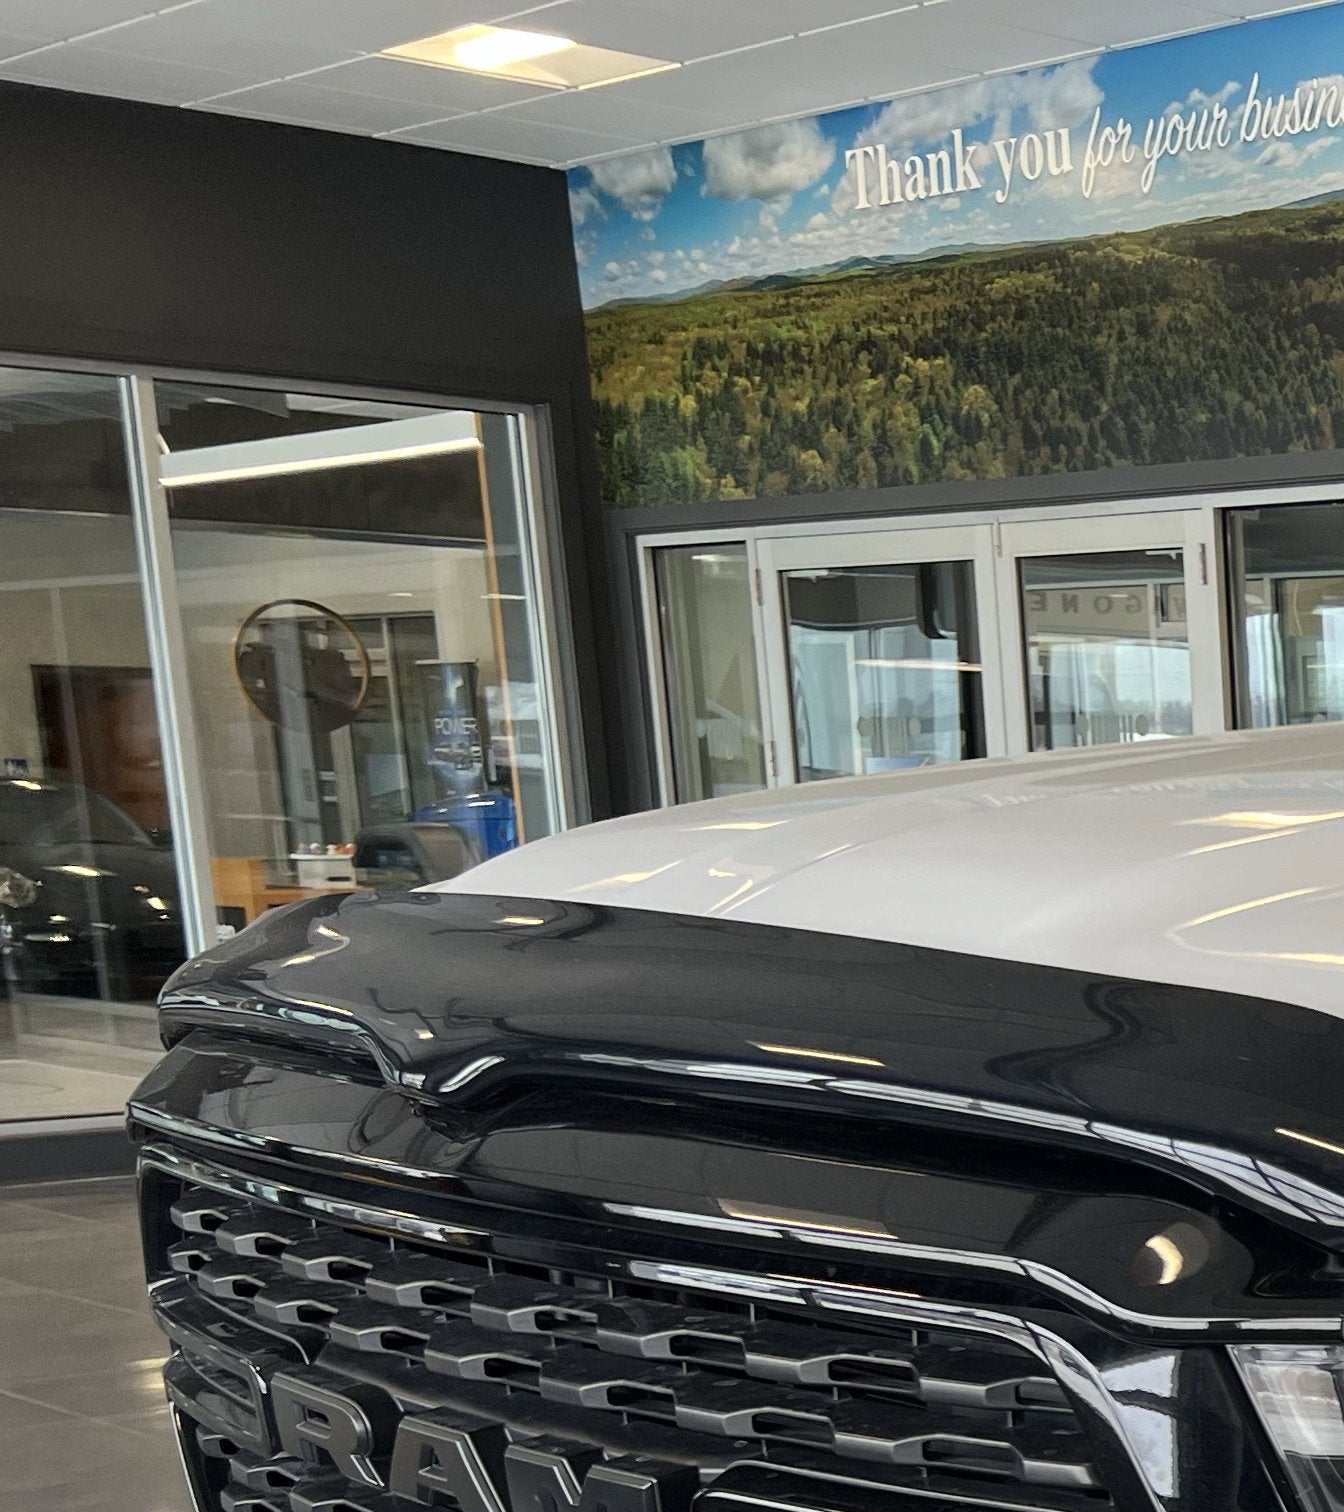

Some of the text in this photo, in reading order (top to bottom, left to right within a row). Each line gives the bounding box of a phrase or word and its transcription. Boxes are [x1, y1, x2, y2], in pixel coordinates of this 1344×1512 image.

[845, 129, 982, 210] Thank
[993, 128, 1074, 204] you
[1082, 106, 1136, 199] for
[1141, 102, 1231, 195] your
